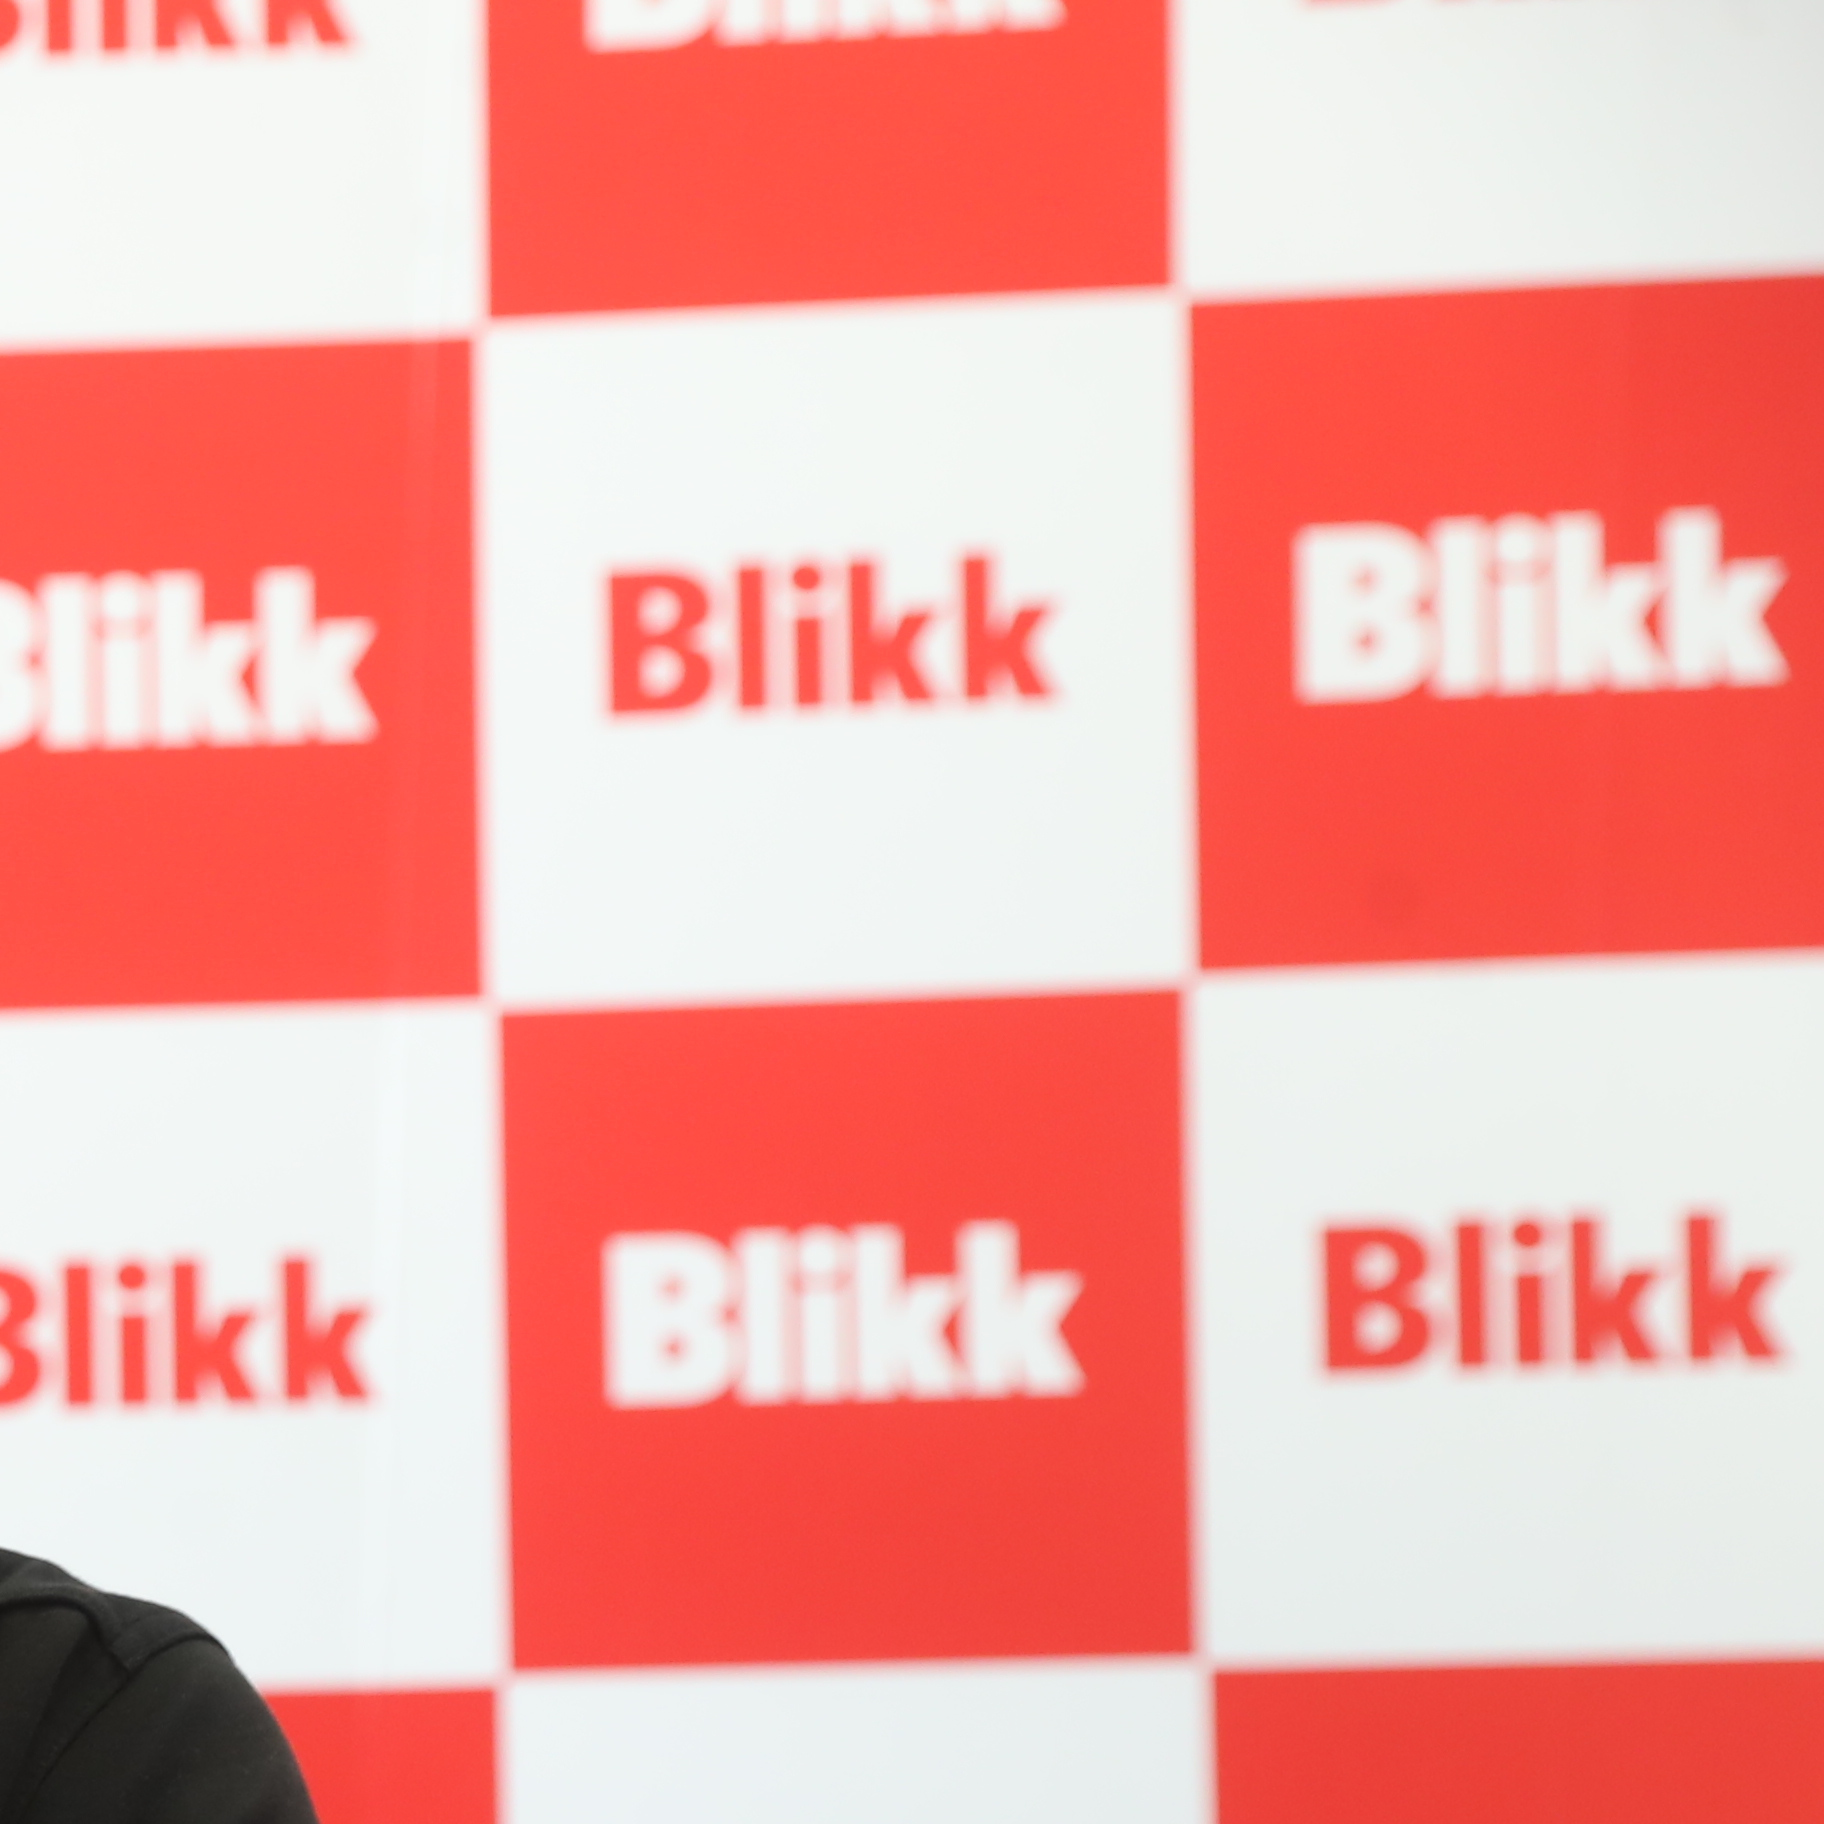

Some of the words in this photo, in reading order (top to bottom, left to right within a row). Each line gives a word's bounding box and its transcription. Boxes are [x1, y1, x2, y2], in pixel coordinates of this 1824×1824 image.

[608, 556, 1049, 715] Blikk
[1297, 510, 1783, 701] Blikk
[606, 1223, 1080, 1406] Blikk
[1324, 1216, 1776, 1371] Blikk
